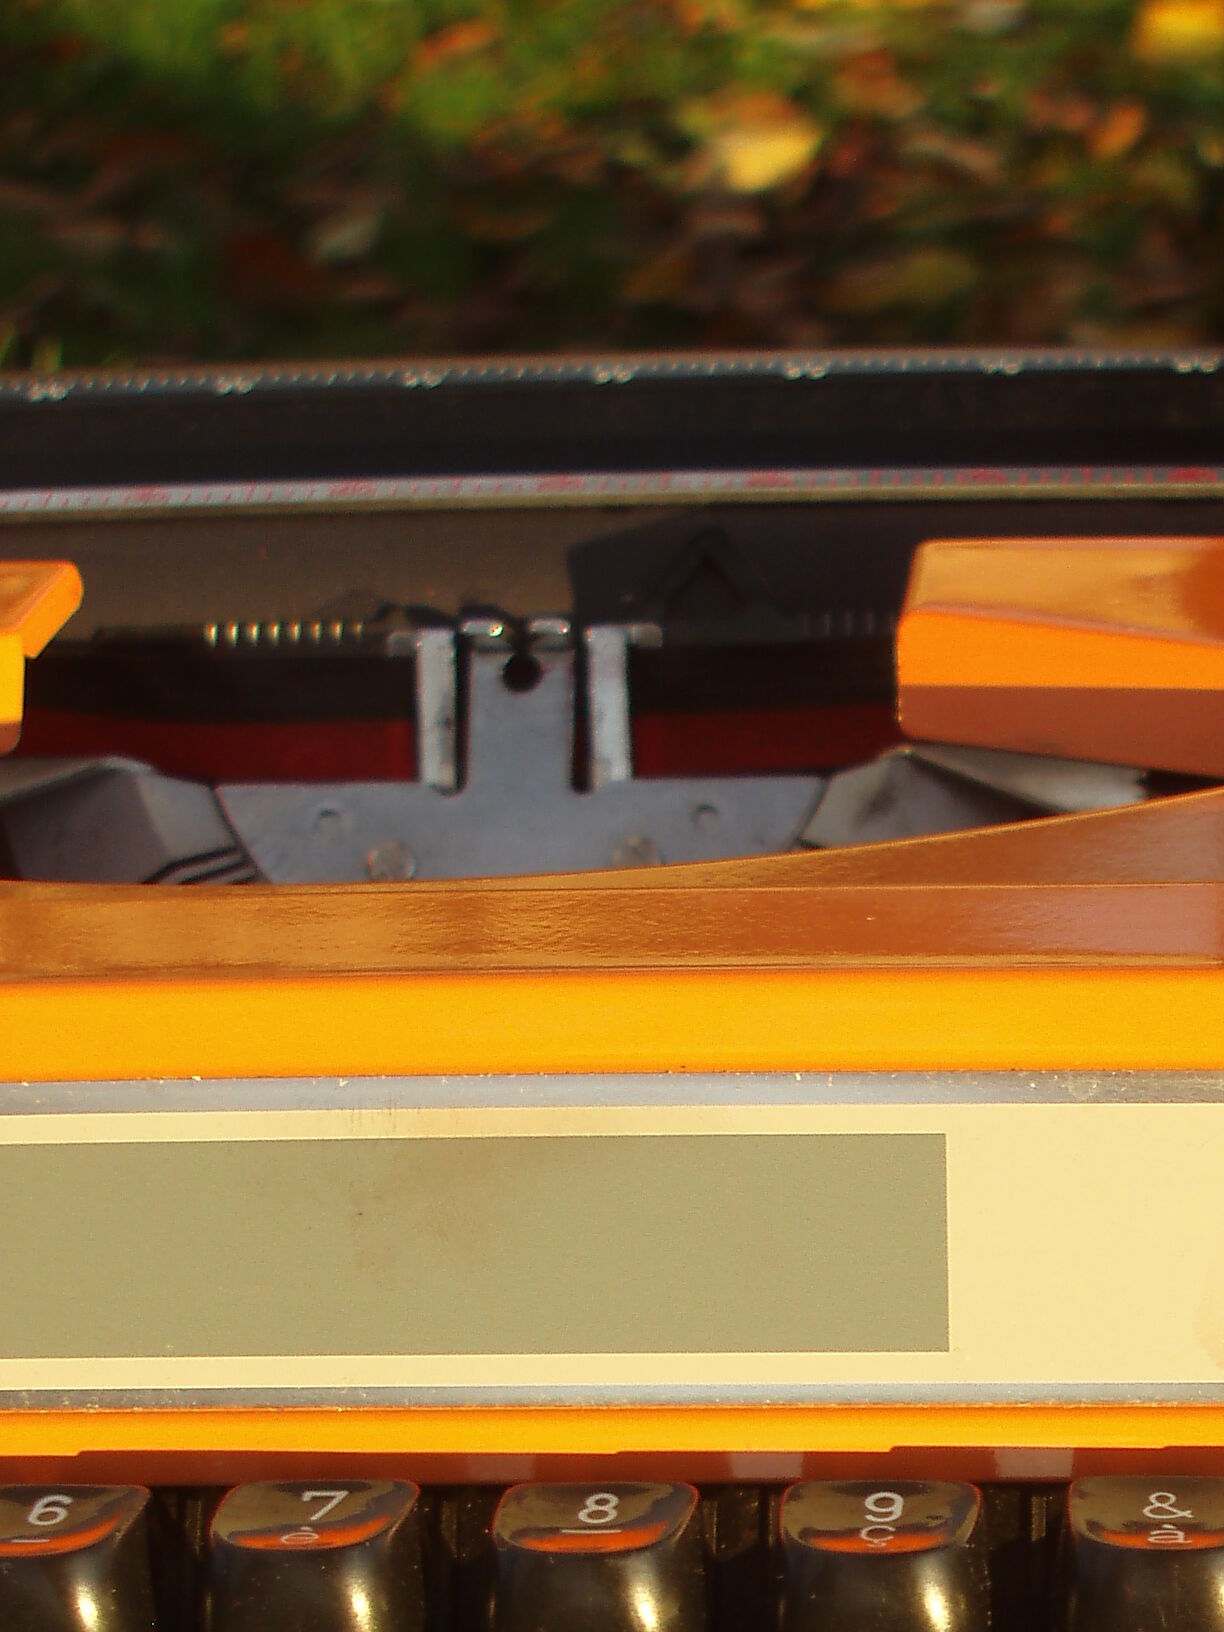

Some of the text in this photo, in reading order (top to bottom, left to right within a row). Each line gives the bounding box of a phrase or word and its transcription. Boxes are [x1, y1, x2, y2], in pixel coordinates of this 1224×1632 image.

[26, 1494, 73, 1526] 6
[301, 1490, 349, 1521] 7
[577, 1493, 619, 1524] 8
[864, 1491, 905, 1523] 9
[1142, 1491, 1194, 1519] &
[859, 1524, 897, 1547] ç
[1147, 1523, 1193, 1544] à
